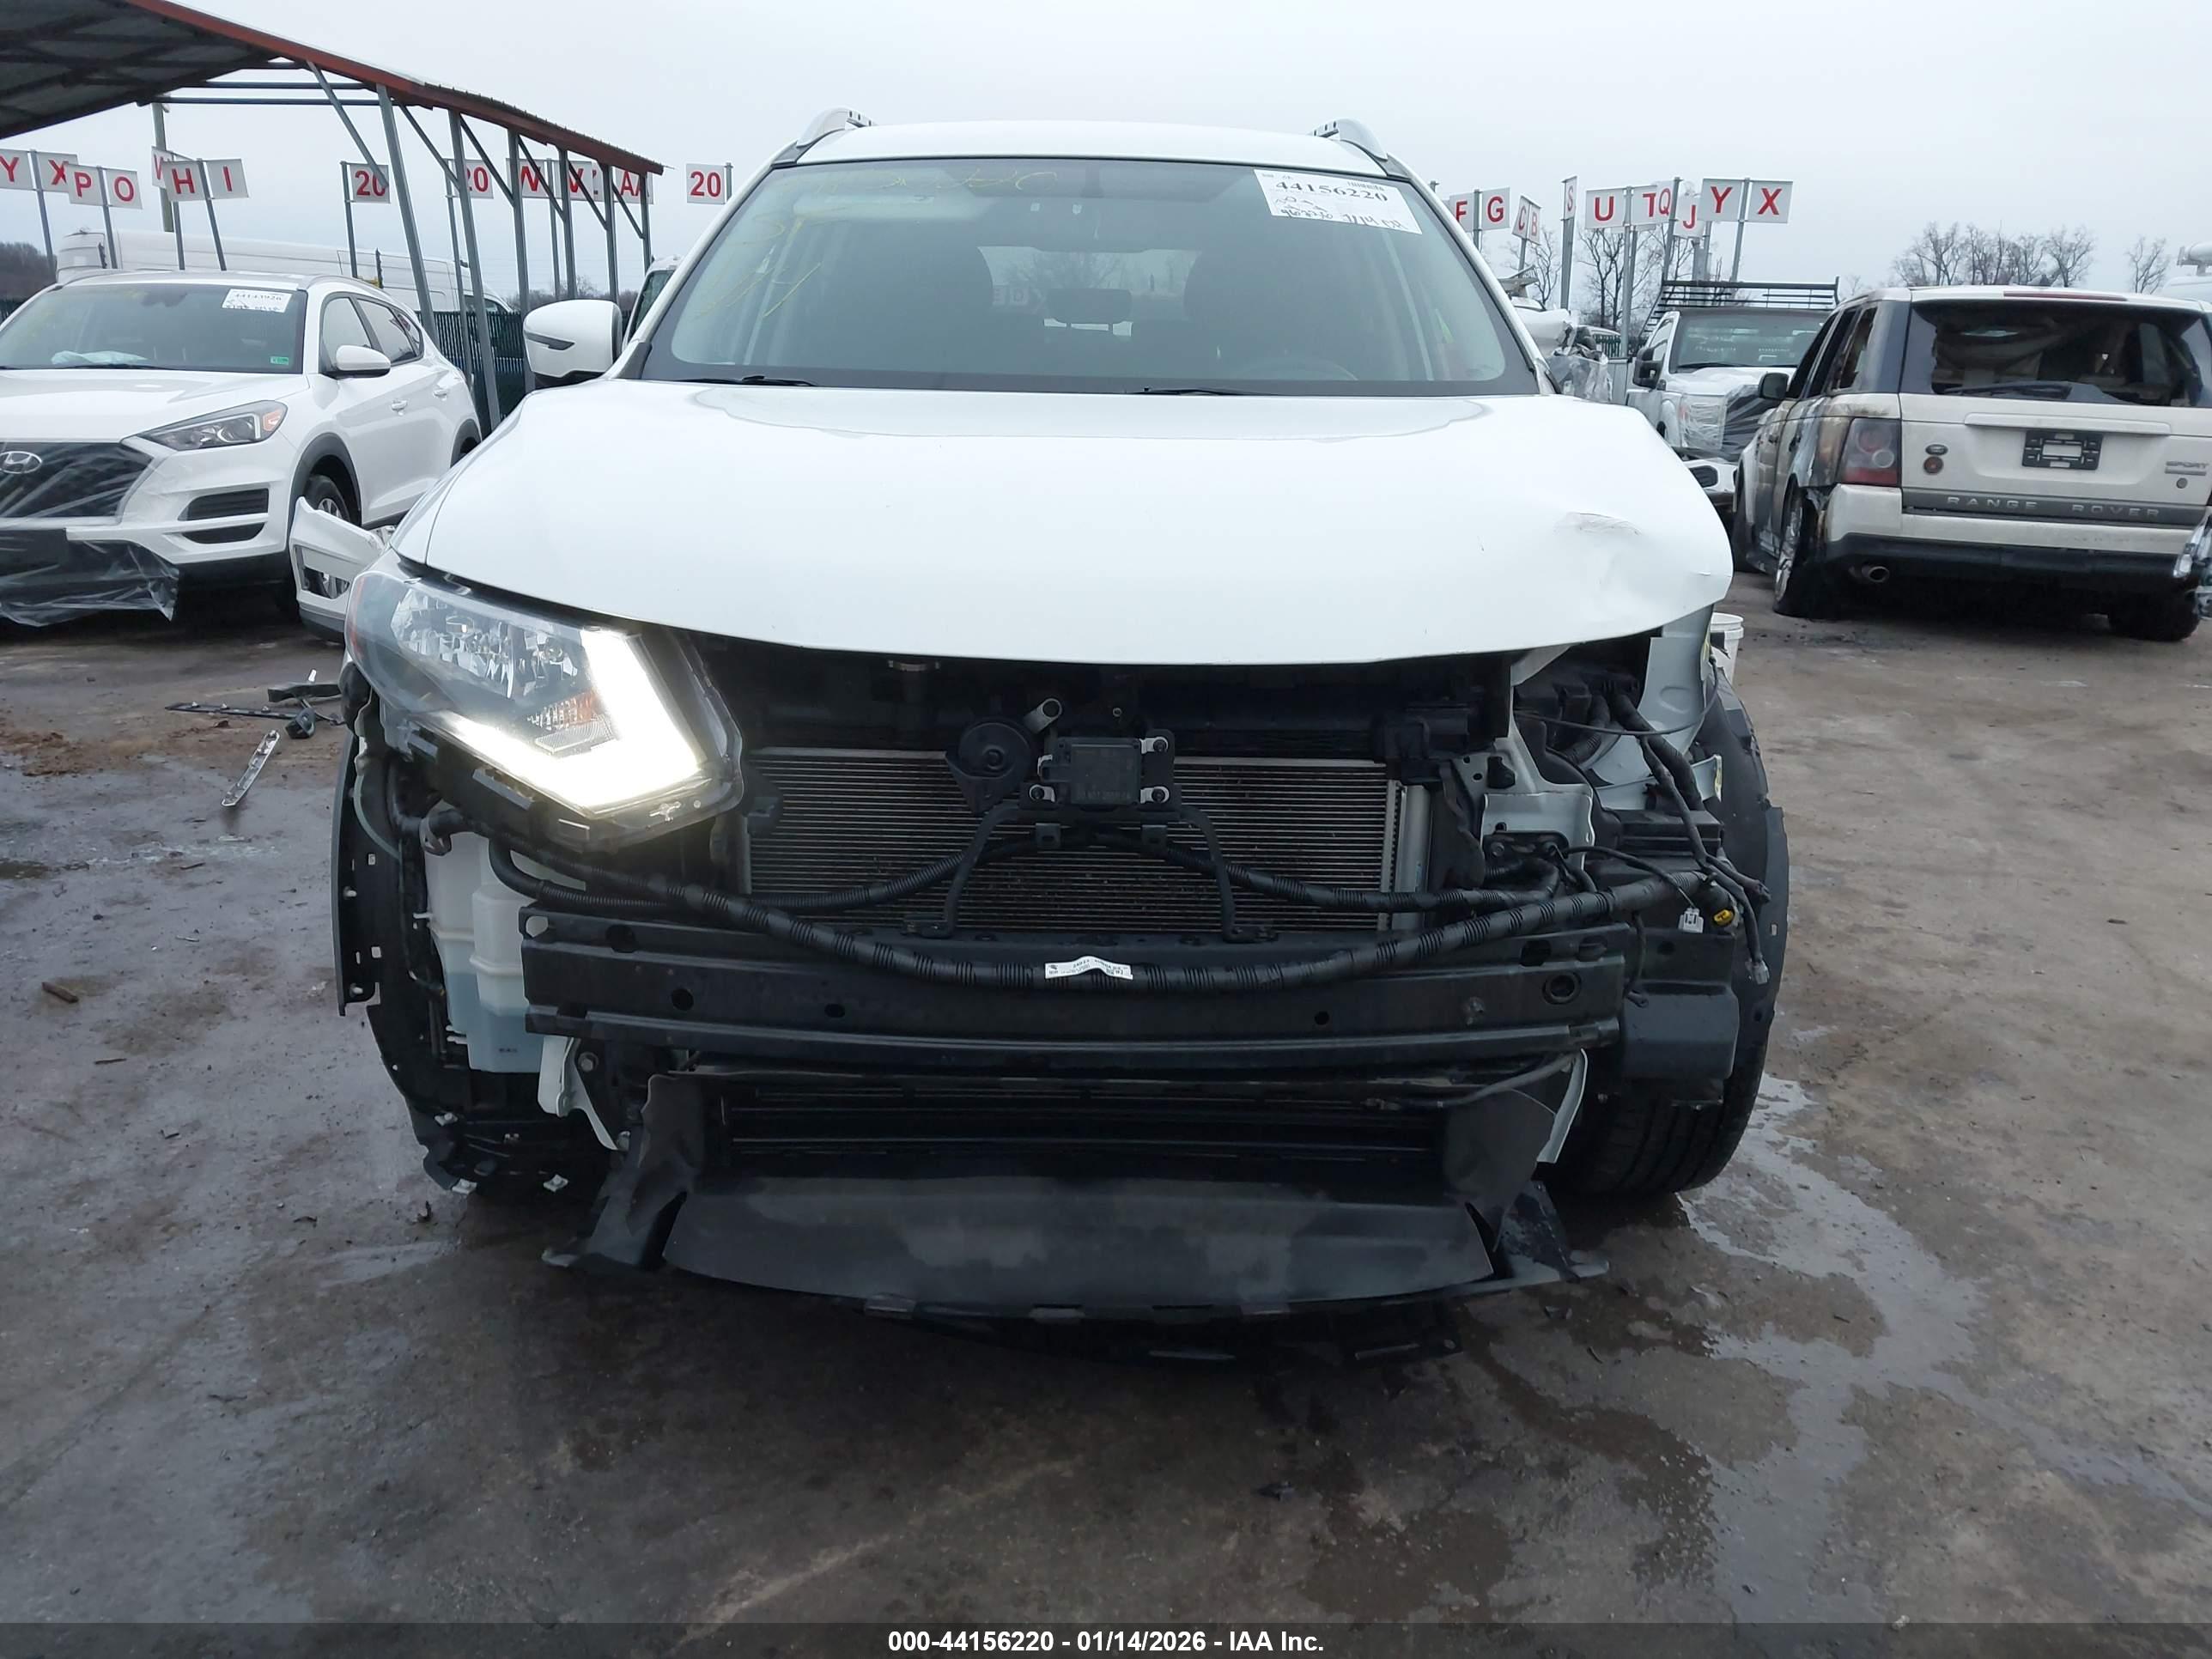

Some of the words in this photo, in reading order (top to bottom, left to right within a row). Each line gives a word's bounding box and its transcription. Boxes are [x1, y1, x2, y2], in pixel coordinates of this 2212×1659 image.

[0, 156, 19, 182] Y
[48, 159, 69, 185] X
[171, 167, 196, 194] H
[222, 166, 233, 191] I
[75, 172, 92, 198] P
[114, 176, 134, 202] O
[690, 171, 721, 198] 20
[1276, 180, 1389, 202] 44156220
[1455, 200, 1468, 223] F
[1487, 196, 1504, 222] G
[1566, 185, 1574, 212] S
[1595, 196, 1613, 221] U
[1658, 187, 1671, 216] Q
[1710, 185, 1732, 214] Y
[1757, 187, 1783, 216] X
[1518, 206, 1527, 231] C
[1531, 215, 1538, 236] B
[1682, 204, 1697, 229] J
[1947, 496, 2039, 509] RANGE
[2071, 503, 2160, 517] ROVER
